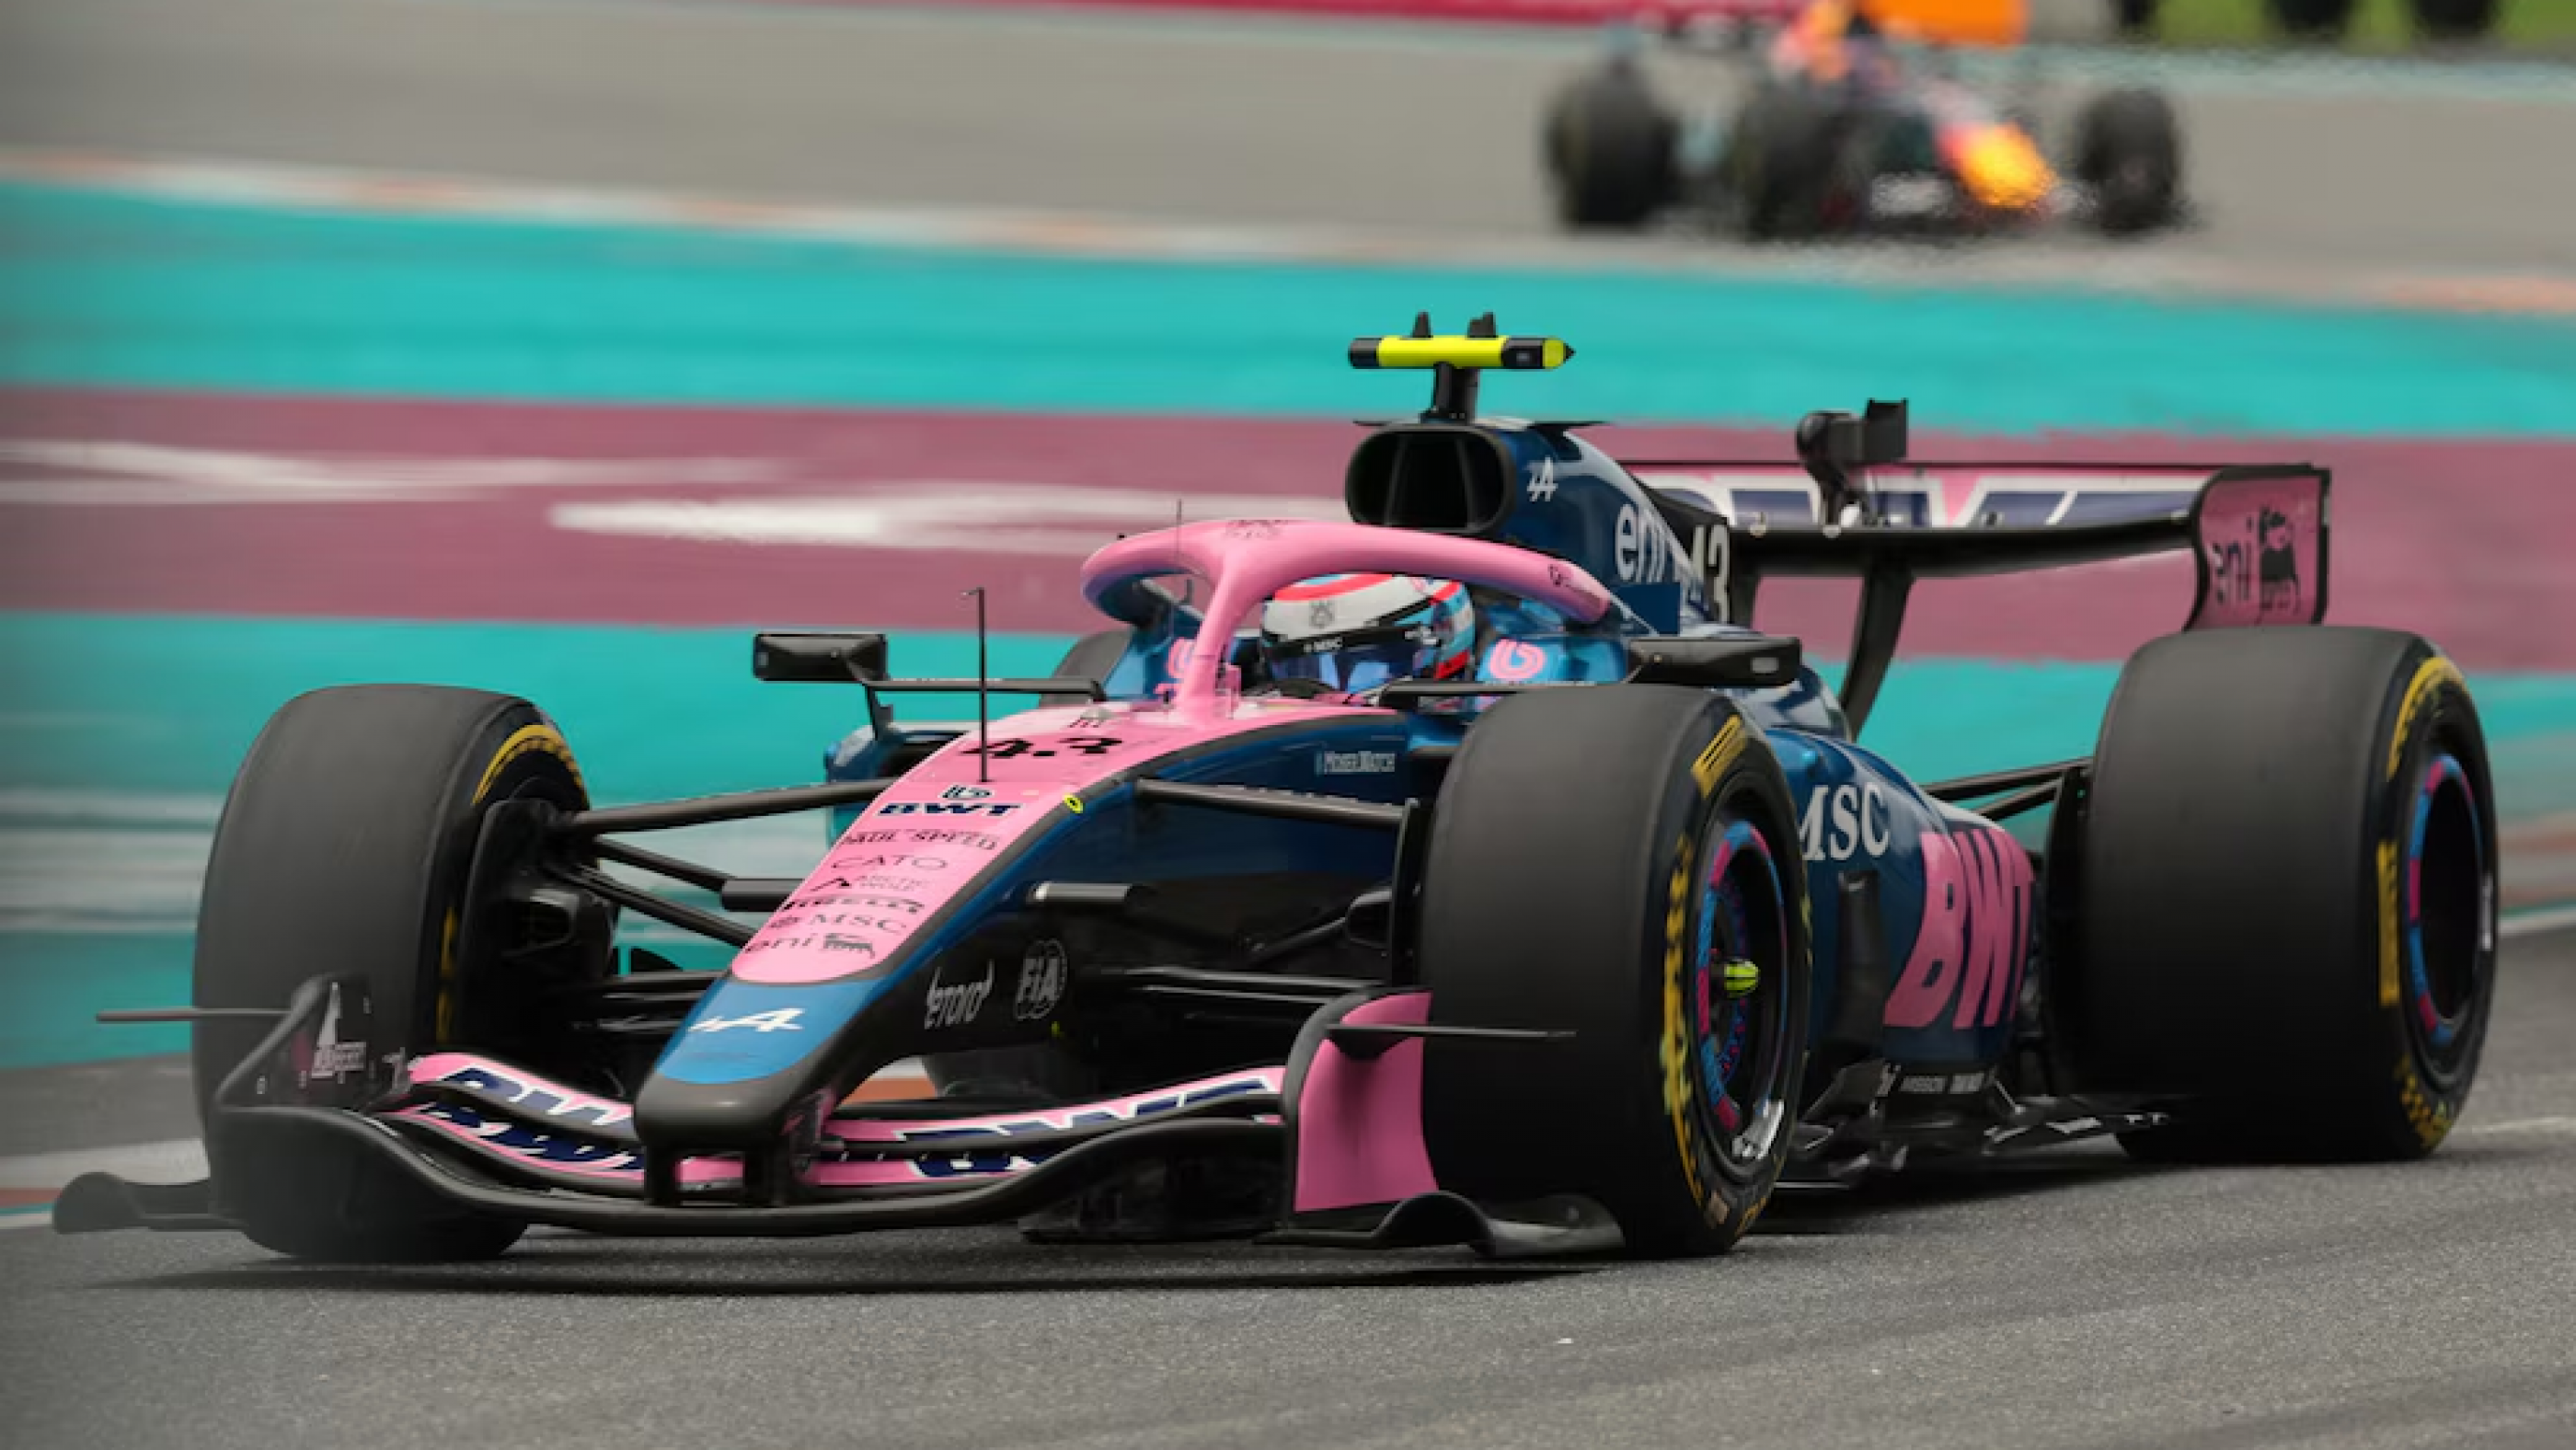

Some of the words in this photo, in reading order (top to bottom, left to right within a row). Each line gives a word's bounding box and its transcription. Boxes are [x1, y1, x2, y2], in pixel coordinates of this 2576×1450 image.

[877, 802, 1024, 817] BWT
[831, 855, 949, 870] CATO
[809, 914, 907, 933] MSC
[1882, 827, 2035, 1030] BWT
